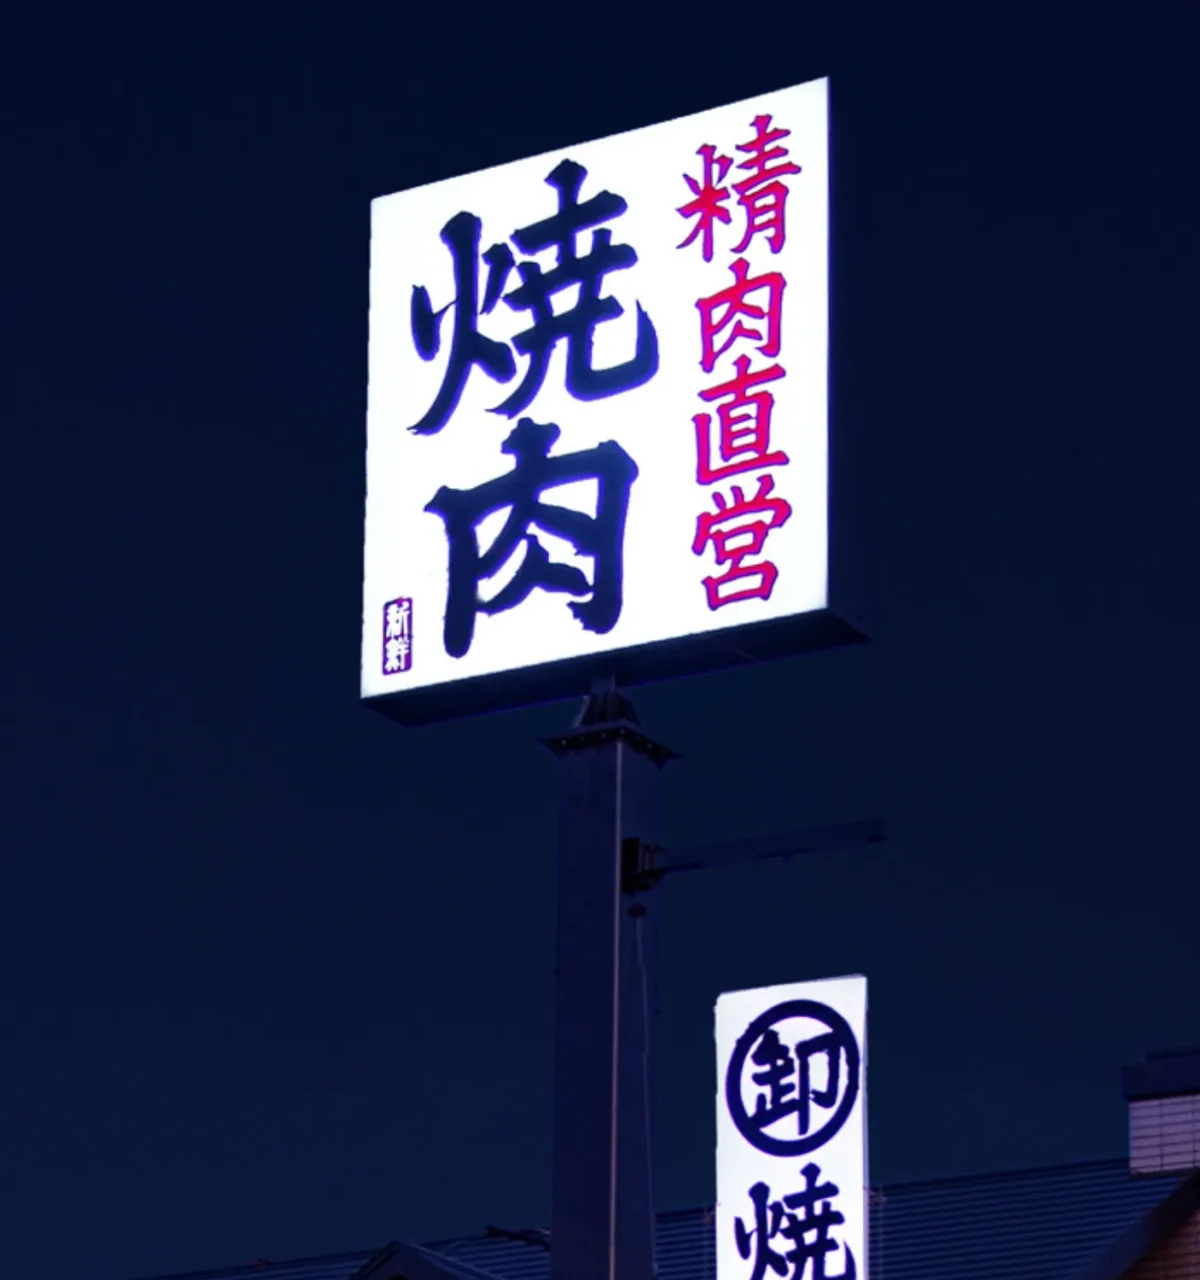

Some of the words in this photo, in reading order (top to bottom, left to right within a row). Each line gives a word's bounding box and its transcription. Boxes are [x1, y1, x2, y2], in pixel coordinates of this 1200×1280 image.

[407, 158, 660, 660] 焼肉
[676, 114, 802, 610] 精肉直営
[749, 1030, 839, 1136] 卸
